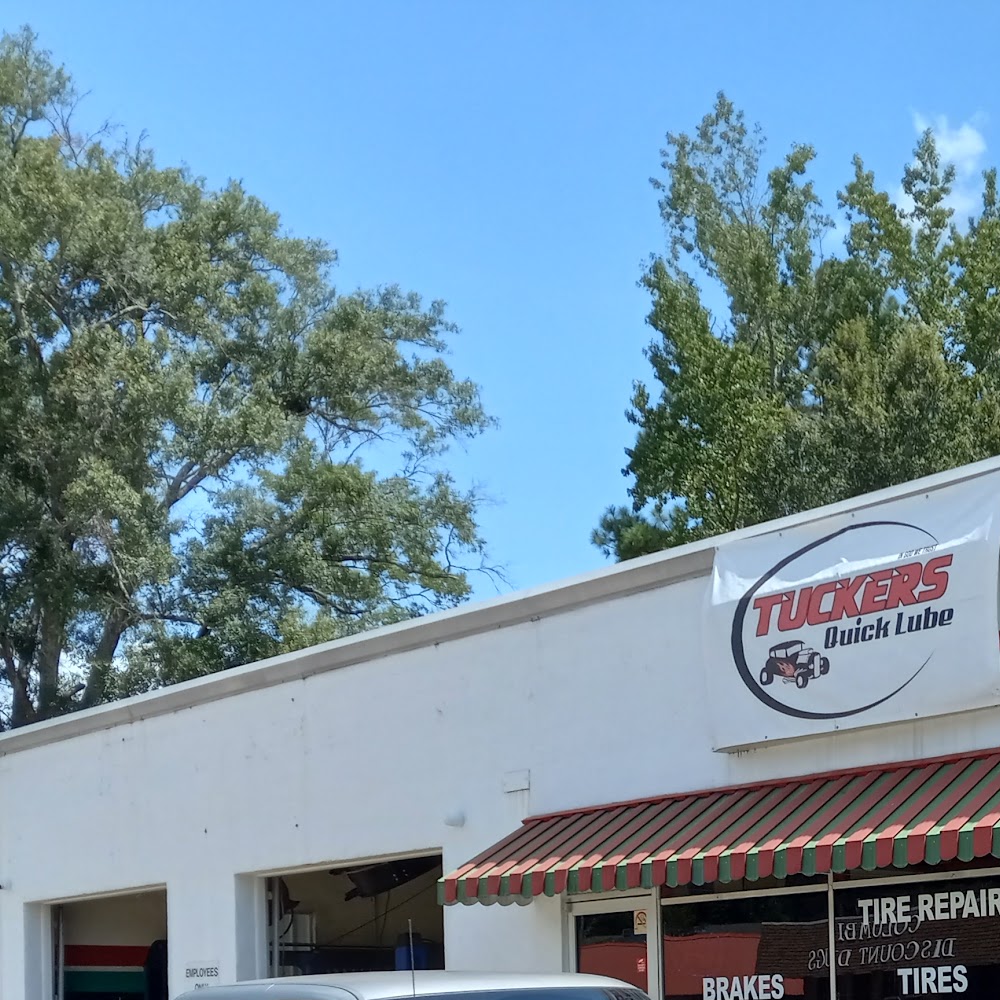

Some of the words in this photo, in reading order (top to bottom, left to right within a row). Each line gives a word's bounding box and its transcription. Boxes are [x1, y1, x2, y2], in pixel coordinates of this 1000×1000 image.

[753, 554, 954, 637] TUCKERS
[824, 617, 890, 649] Quick
[895, 606, 954, 636] Lube
[857, 895, 912, 926] TIRE
[185, 967, 219, 978] EMPLOYEES
[897, 964, 969, 995] TIRES
